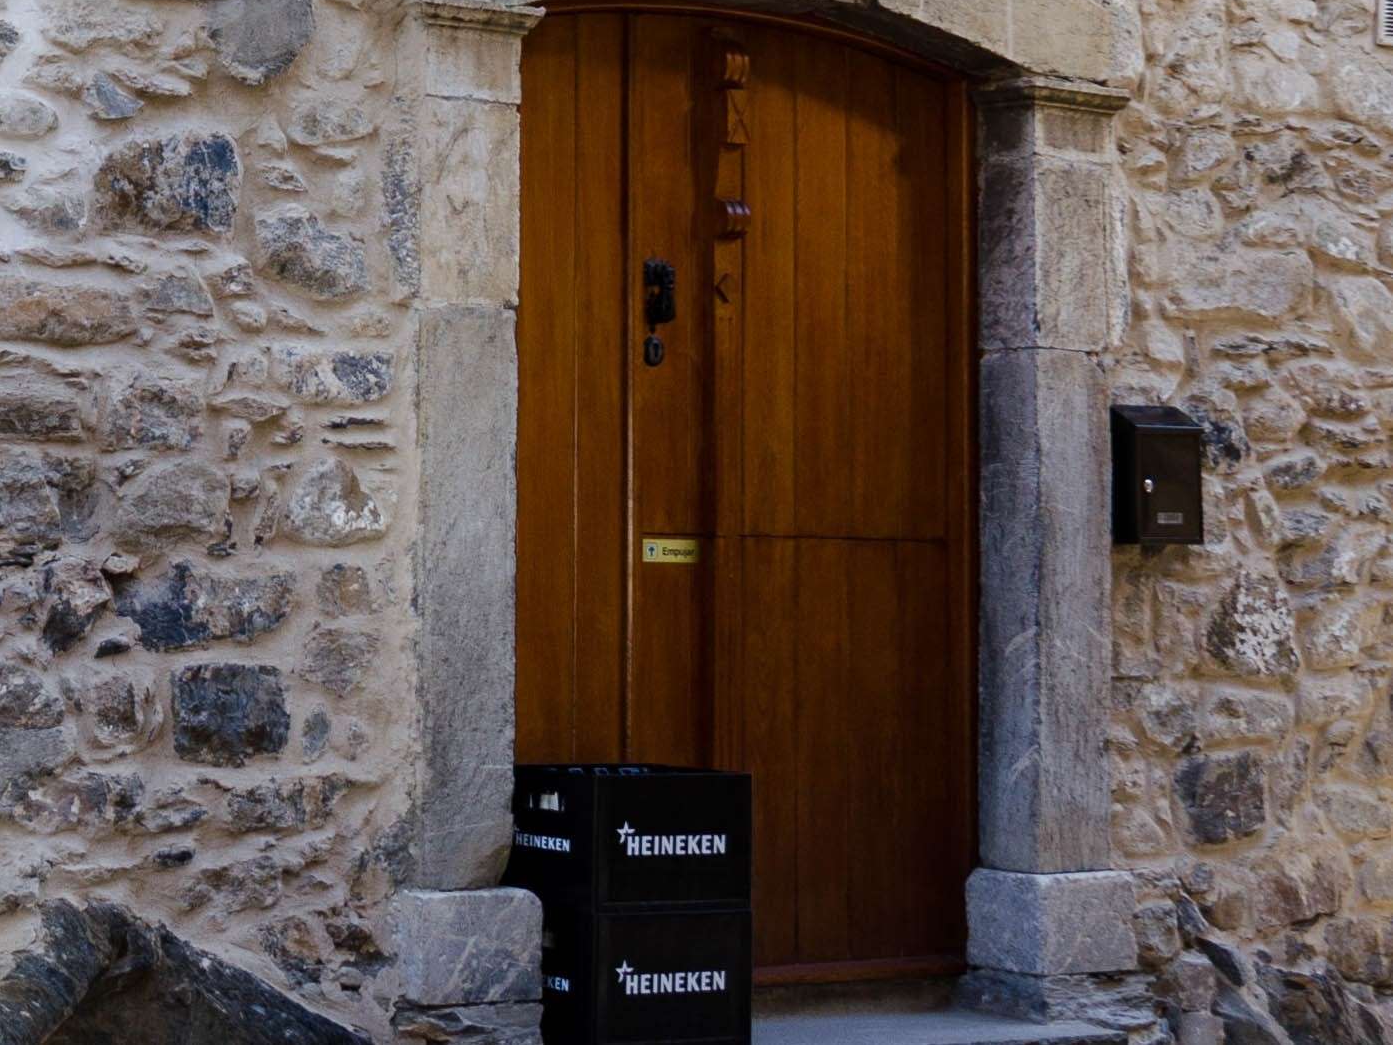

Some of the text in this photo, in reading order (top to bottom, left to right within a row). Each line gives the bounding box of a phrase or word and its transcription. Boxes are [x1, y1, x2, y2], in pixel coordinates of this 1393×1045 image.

[515, 832, 571, 852] HEINEKEN
[626, 834, 727, 857] HEINEKEN
[625, 970, 727, 995] HEINEKEN
